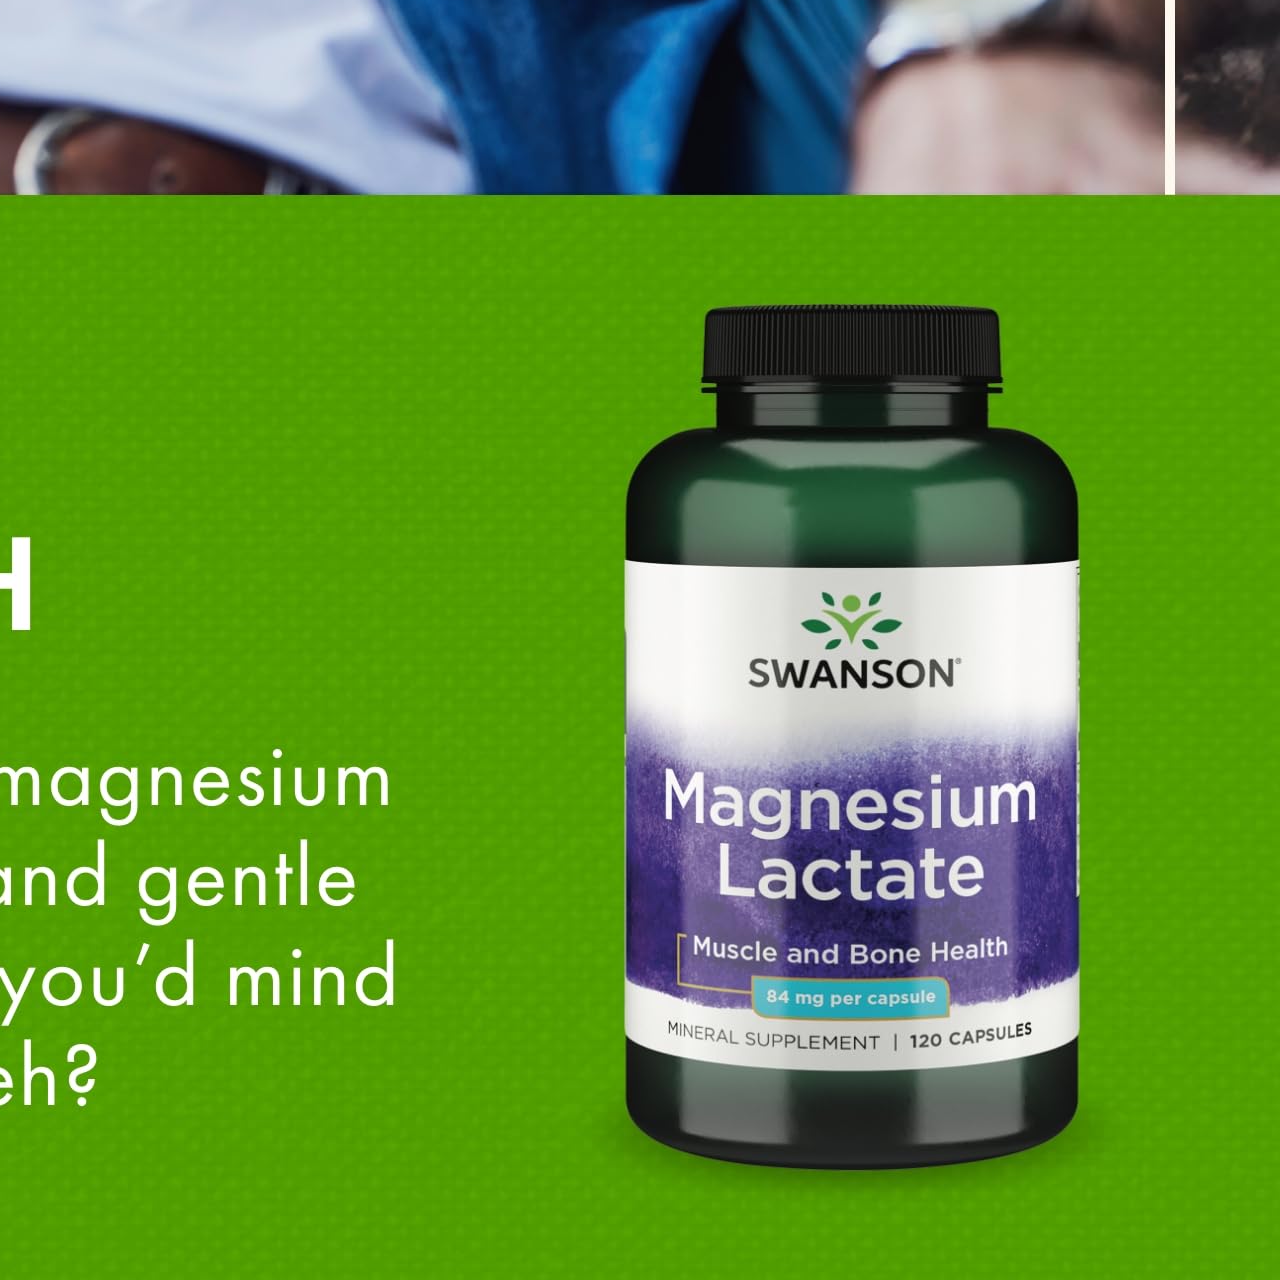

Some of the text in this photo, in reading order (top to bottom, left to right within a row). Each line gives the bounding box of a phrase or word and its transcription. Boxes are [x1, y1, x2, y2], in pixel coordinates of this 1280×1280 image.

[664, 767, 1036, 840] Magnesium
[719, 842, 985, 900] Lactate
[693, 936, 1008, 965] Muscle and Bone Health
[767, 990, 936, 1007] 84 mg per capsule
[668, 1021, 1032, 1050] MINERAL SUPPLEMENT 120 CAPSULES
